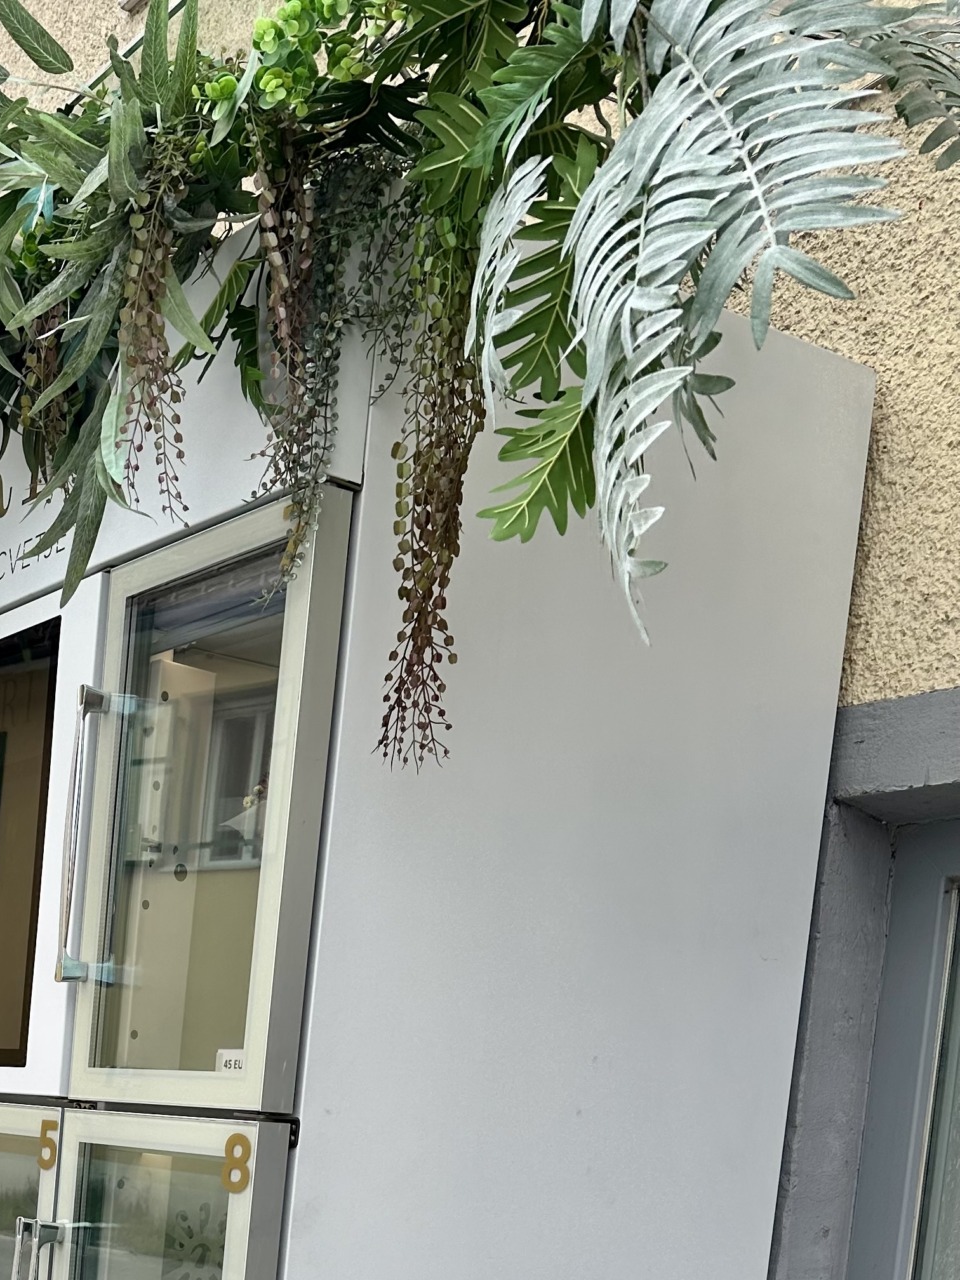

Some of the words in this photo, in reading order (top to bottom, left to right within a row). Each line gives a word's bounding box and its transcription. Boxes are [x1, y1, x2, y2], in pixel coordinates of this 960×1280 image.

[223, 1059, 233, 1070] 45
[37, 1119, 59, 1171] 5
[221, 1132, 252, 1194] 8
